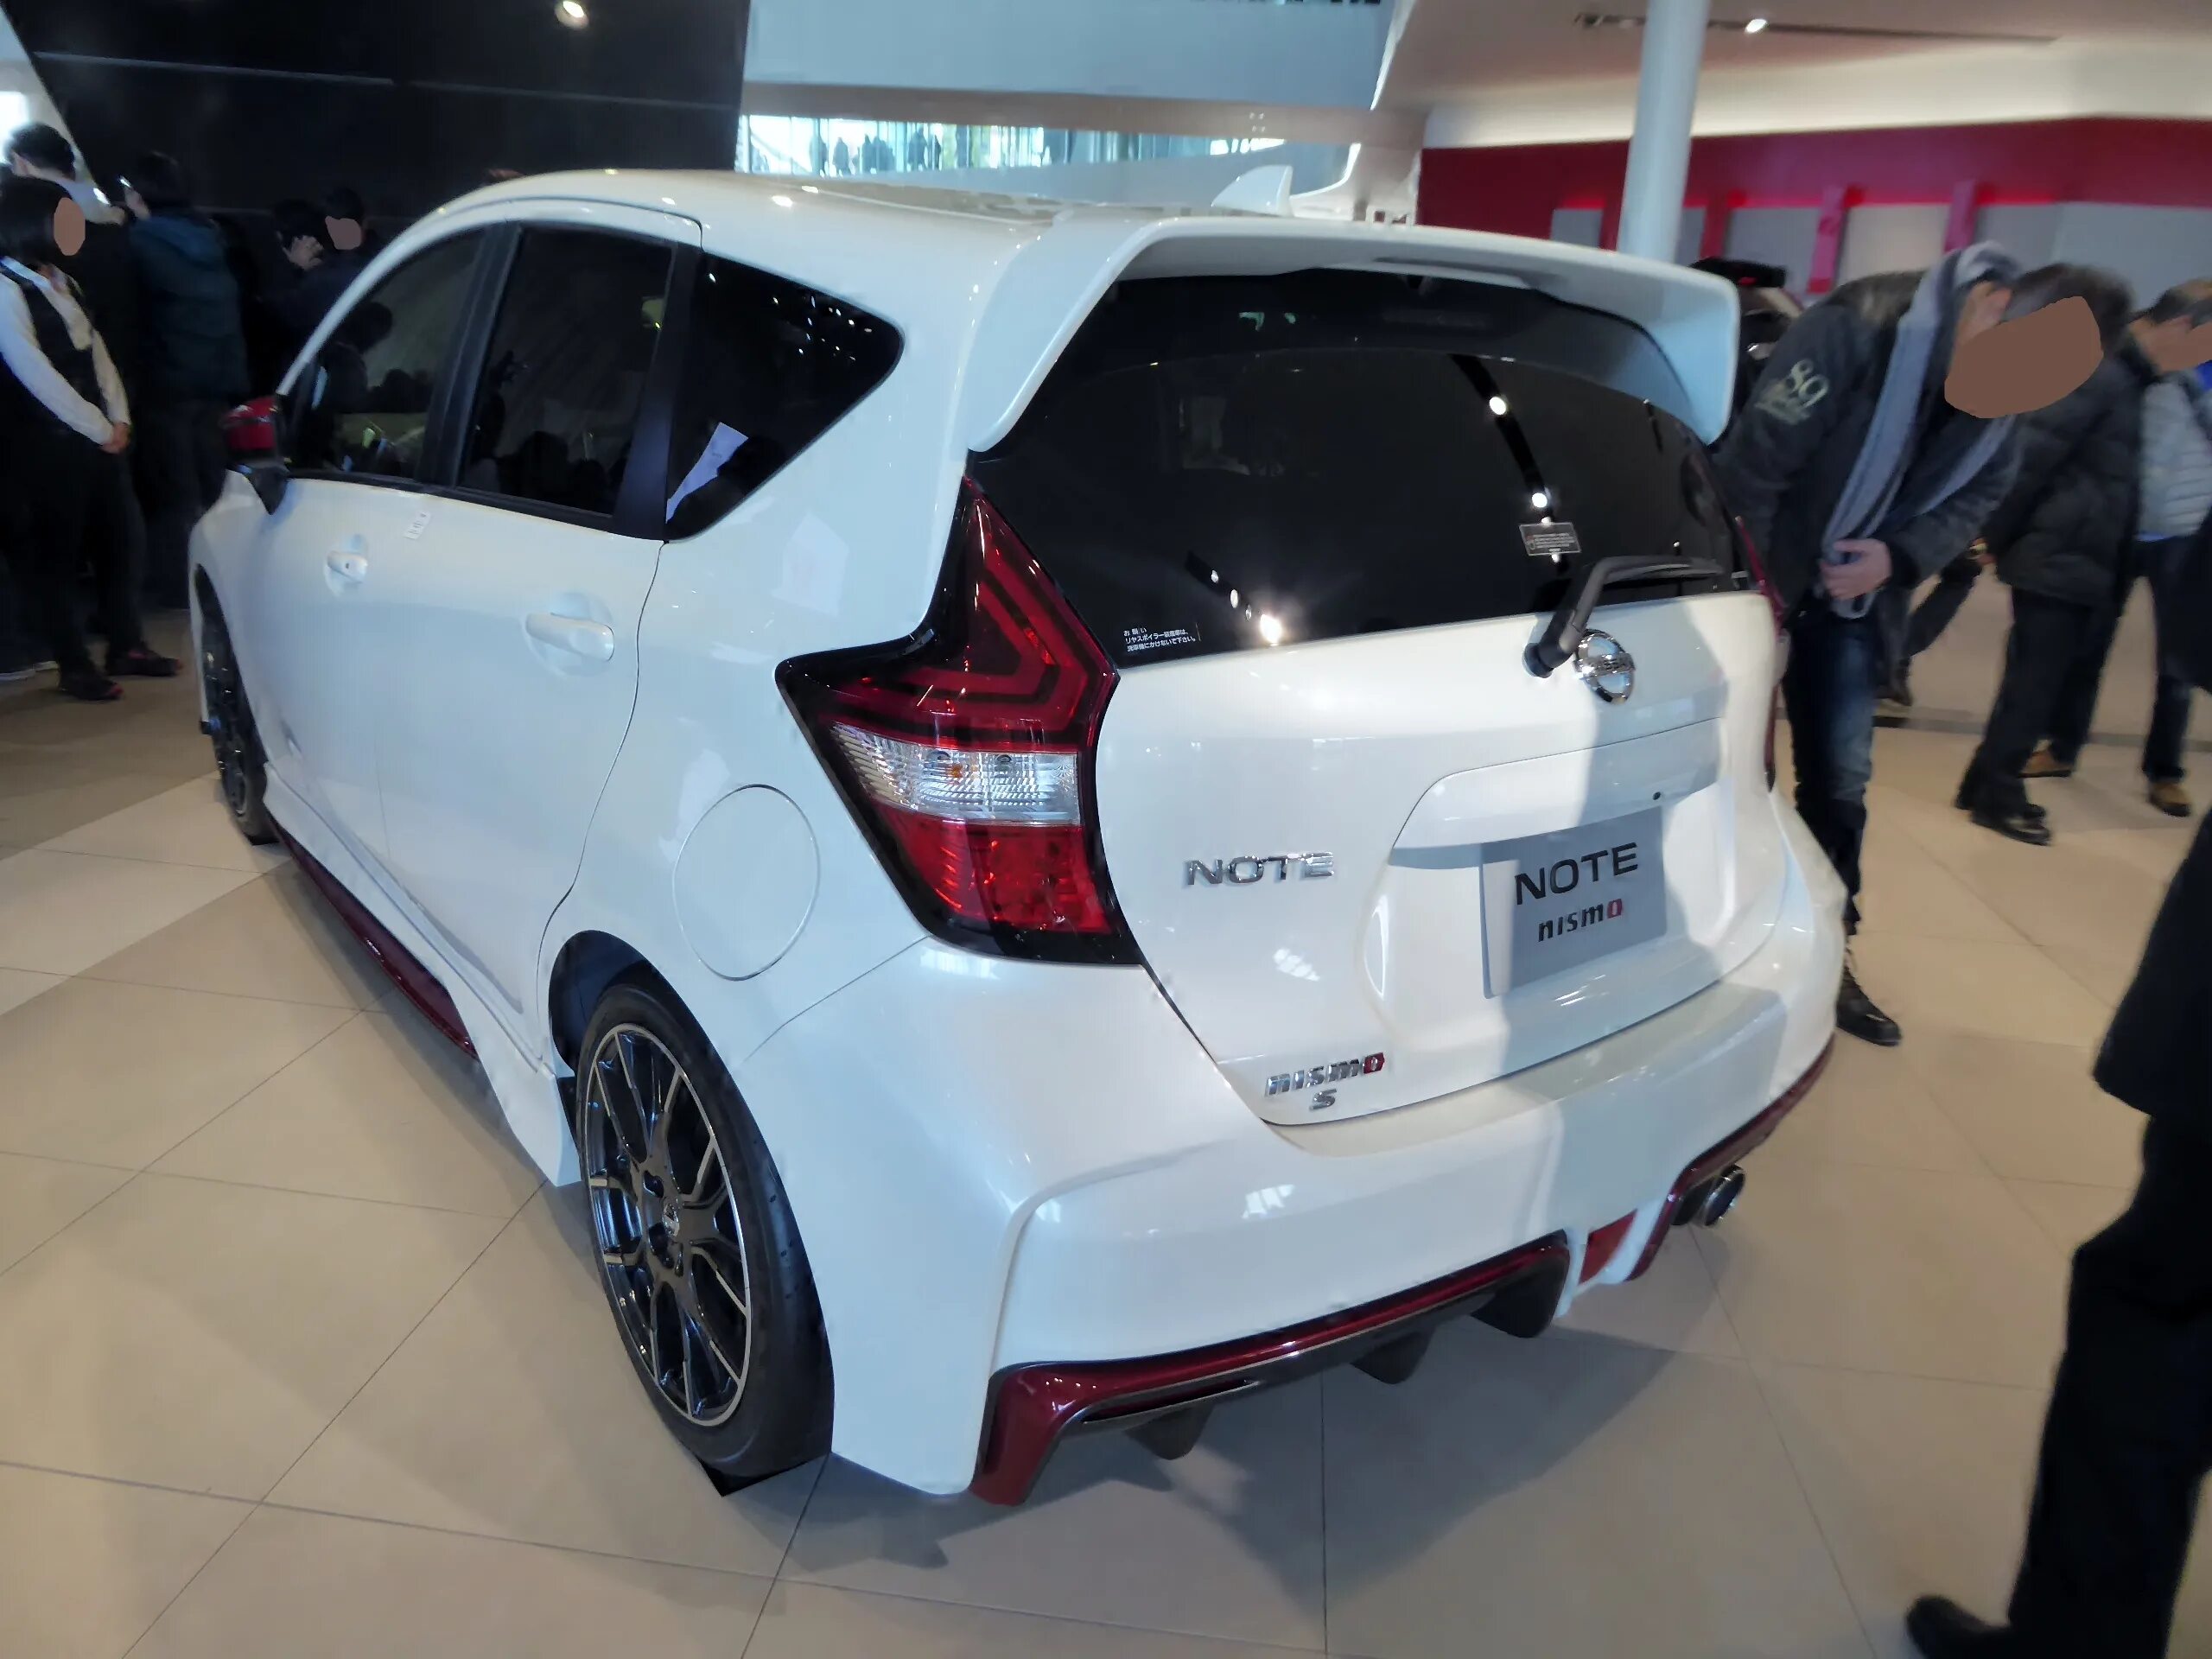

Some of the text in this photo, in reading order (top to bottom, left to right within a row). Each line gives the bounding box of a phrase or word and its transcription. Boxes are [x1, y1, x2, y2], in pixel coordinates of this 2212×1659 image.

[1186, 851, 1334, 886] NOTE
[1516, 842, 1638, 906] NOTE
[1538, 898, 1623, 942] nismo
[1265, 1052, 1386, 1096] nismo
[1309, 1088, 1338, 1111] S
